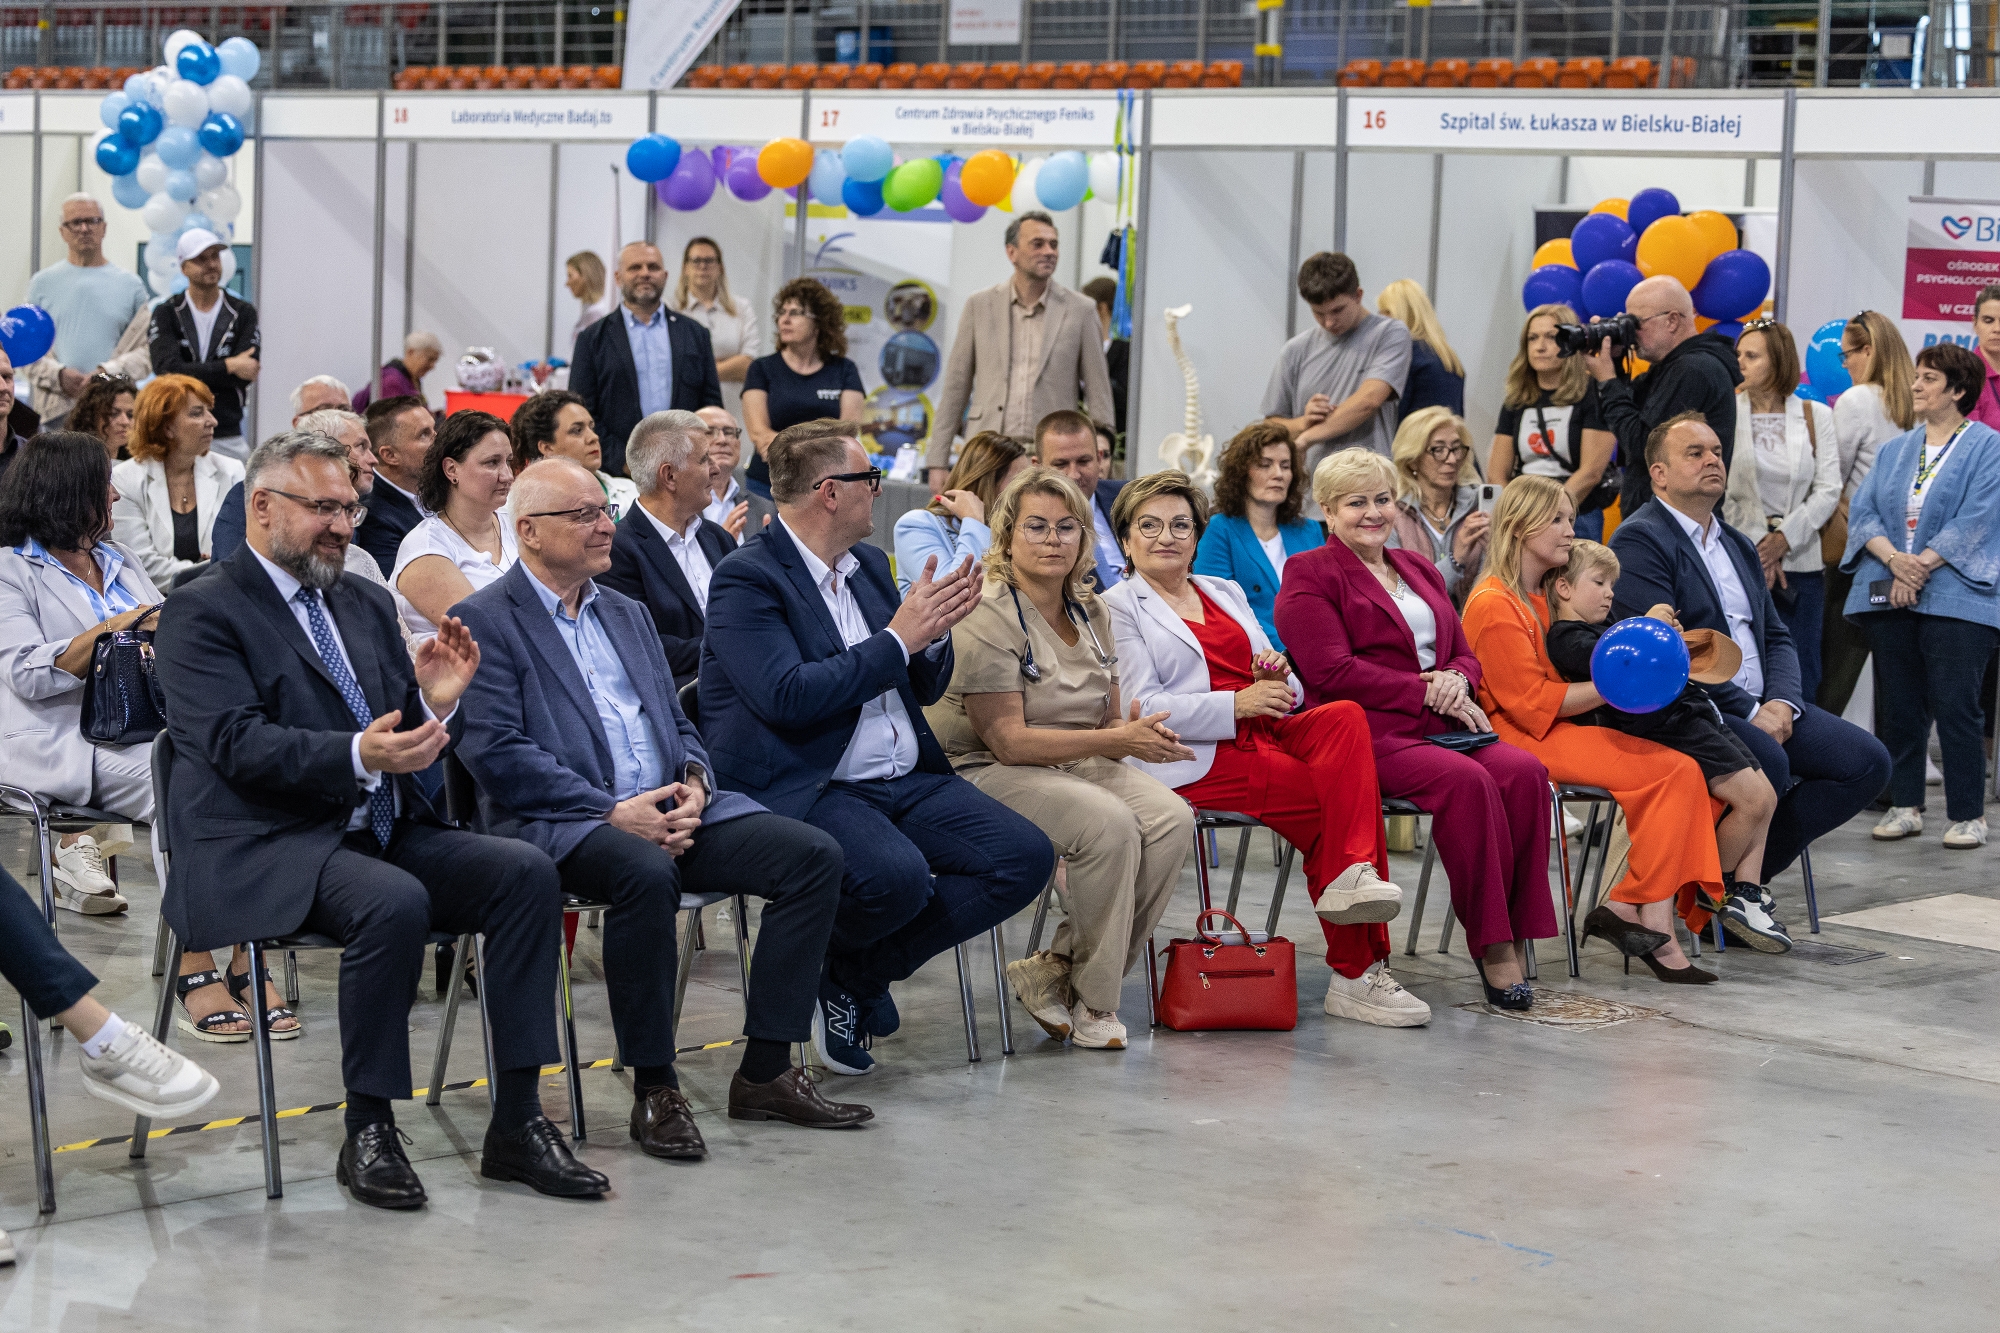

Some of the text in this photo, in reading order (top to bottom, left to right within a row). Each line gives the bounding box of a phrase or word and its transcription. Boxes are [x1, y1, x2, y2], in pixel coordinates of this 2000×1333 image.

[393, 107, 409, 124] 18
[451, 109, 511, 124] Laboratoria
[513, 109, 564, 127] Medyczne
[821, 110, 840, 127] 17
[895, 106, 1095, 124] Centrum Zdrowia Psychicznego Feniks
[1363, 110, 1386, 129] 16
[951, 123, 1034, 139] w Bielsku-Białej
[1440, 112, 1742, 138] Szpital św. Łukasza w Bielsku-Białej
[1947, 260, 1999, 272] OŚRODEK
[1938, 303, 1953, 315] W
